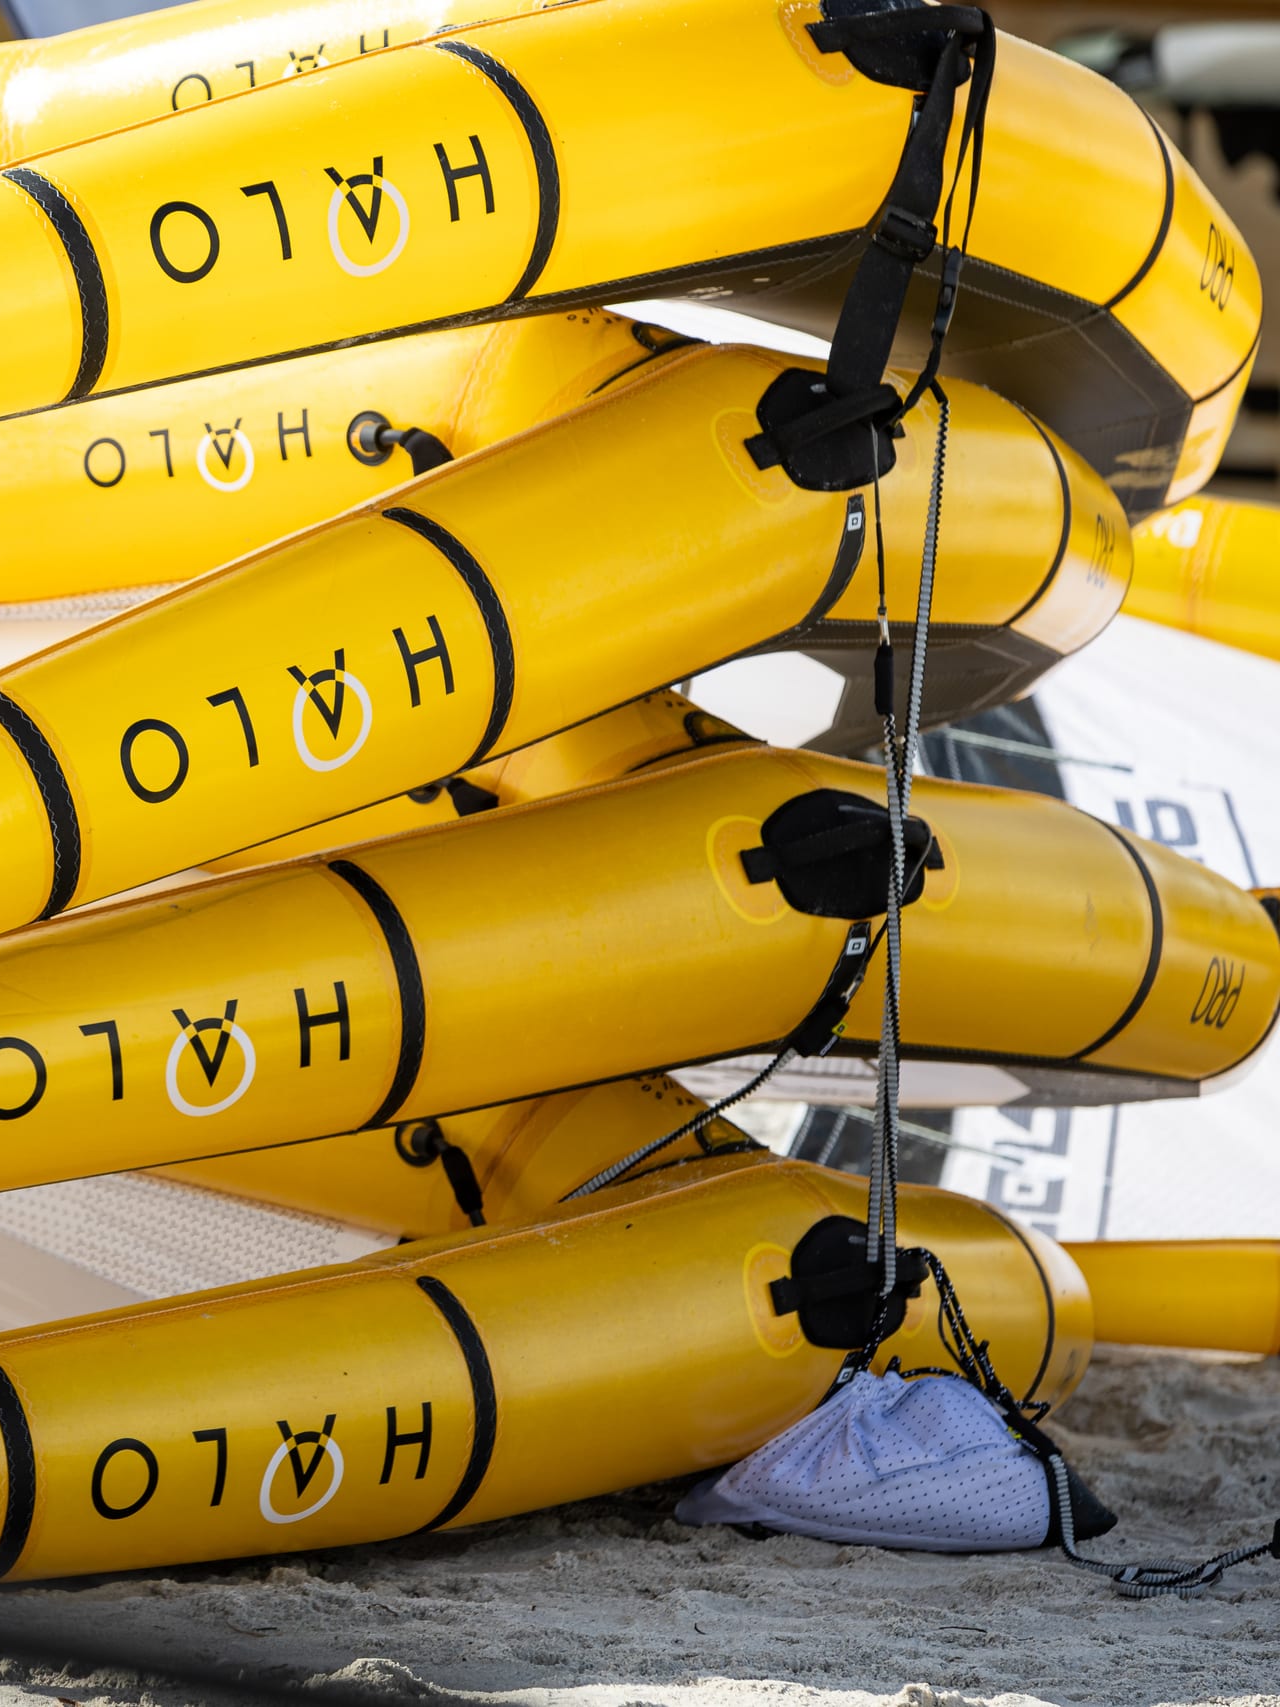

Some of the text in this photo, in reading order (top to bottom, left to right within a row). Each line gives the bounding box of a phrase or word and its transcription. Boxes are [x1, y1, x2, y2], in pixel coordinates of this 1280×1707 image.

[149, 134, 494, 284] HALO
[1200, 221, 1235, 312] PRO
[84, 408, 313, 492] HALO
[120, 614, 455, 803] HALO
[1190, 956, 1245, 1029] PRO
[91, 1402, 433, 1525] HALO
